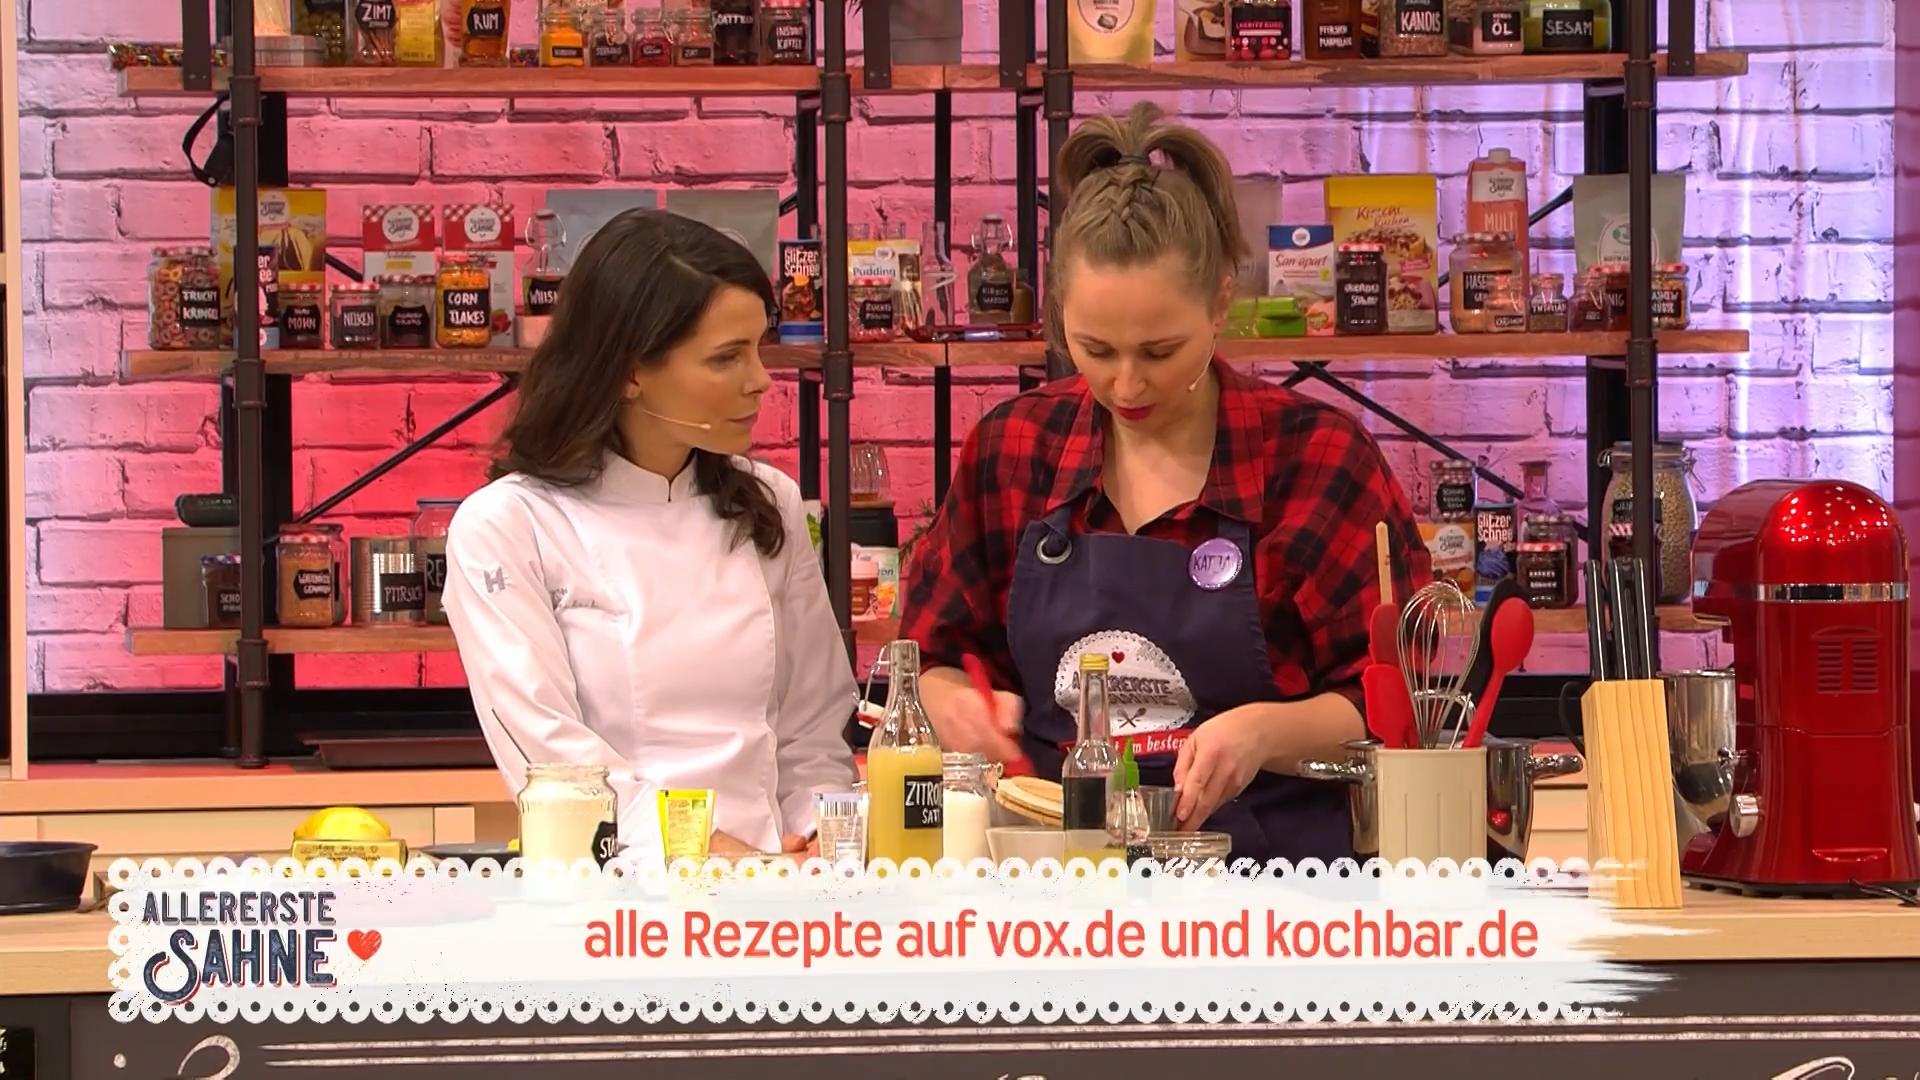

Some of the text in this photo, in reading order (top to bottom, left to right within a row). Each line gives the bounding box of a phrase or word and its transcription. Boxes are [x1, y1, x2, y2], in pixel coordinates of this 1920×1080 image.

[361, 3, 391, 21] ZIMT
[473, 12, 499, 30] RUM
[1400, 11, 1441, 32] KANDIS
[1491, 19, 1514, 36] ÖL
[1544, 18, 1593, 37] SESAM
[1484, 211, 1518, 232] MULTI
[852, 267, 897, 278] Pudding
[447, 292, 479, 306] CORN
[287, 316, 317, 330] MOHN
[448, 310, 486, 326] FLAKES
[1477, 512, 1512, 528] Glitzer
[1477, 526, 1514, 542] Schnee
[427, 559, 445, 588] RE
[220, 593, 241, 605] SCHO
